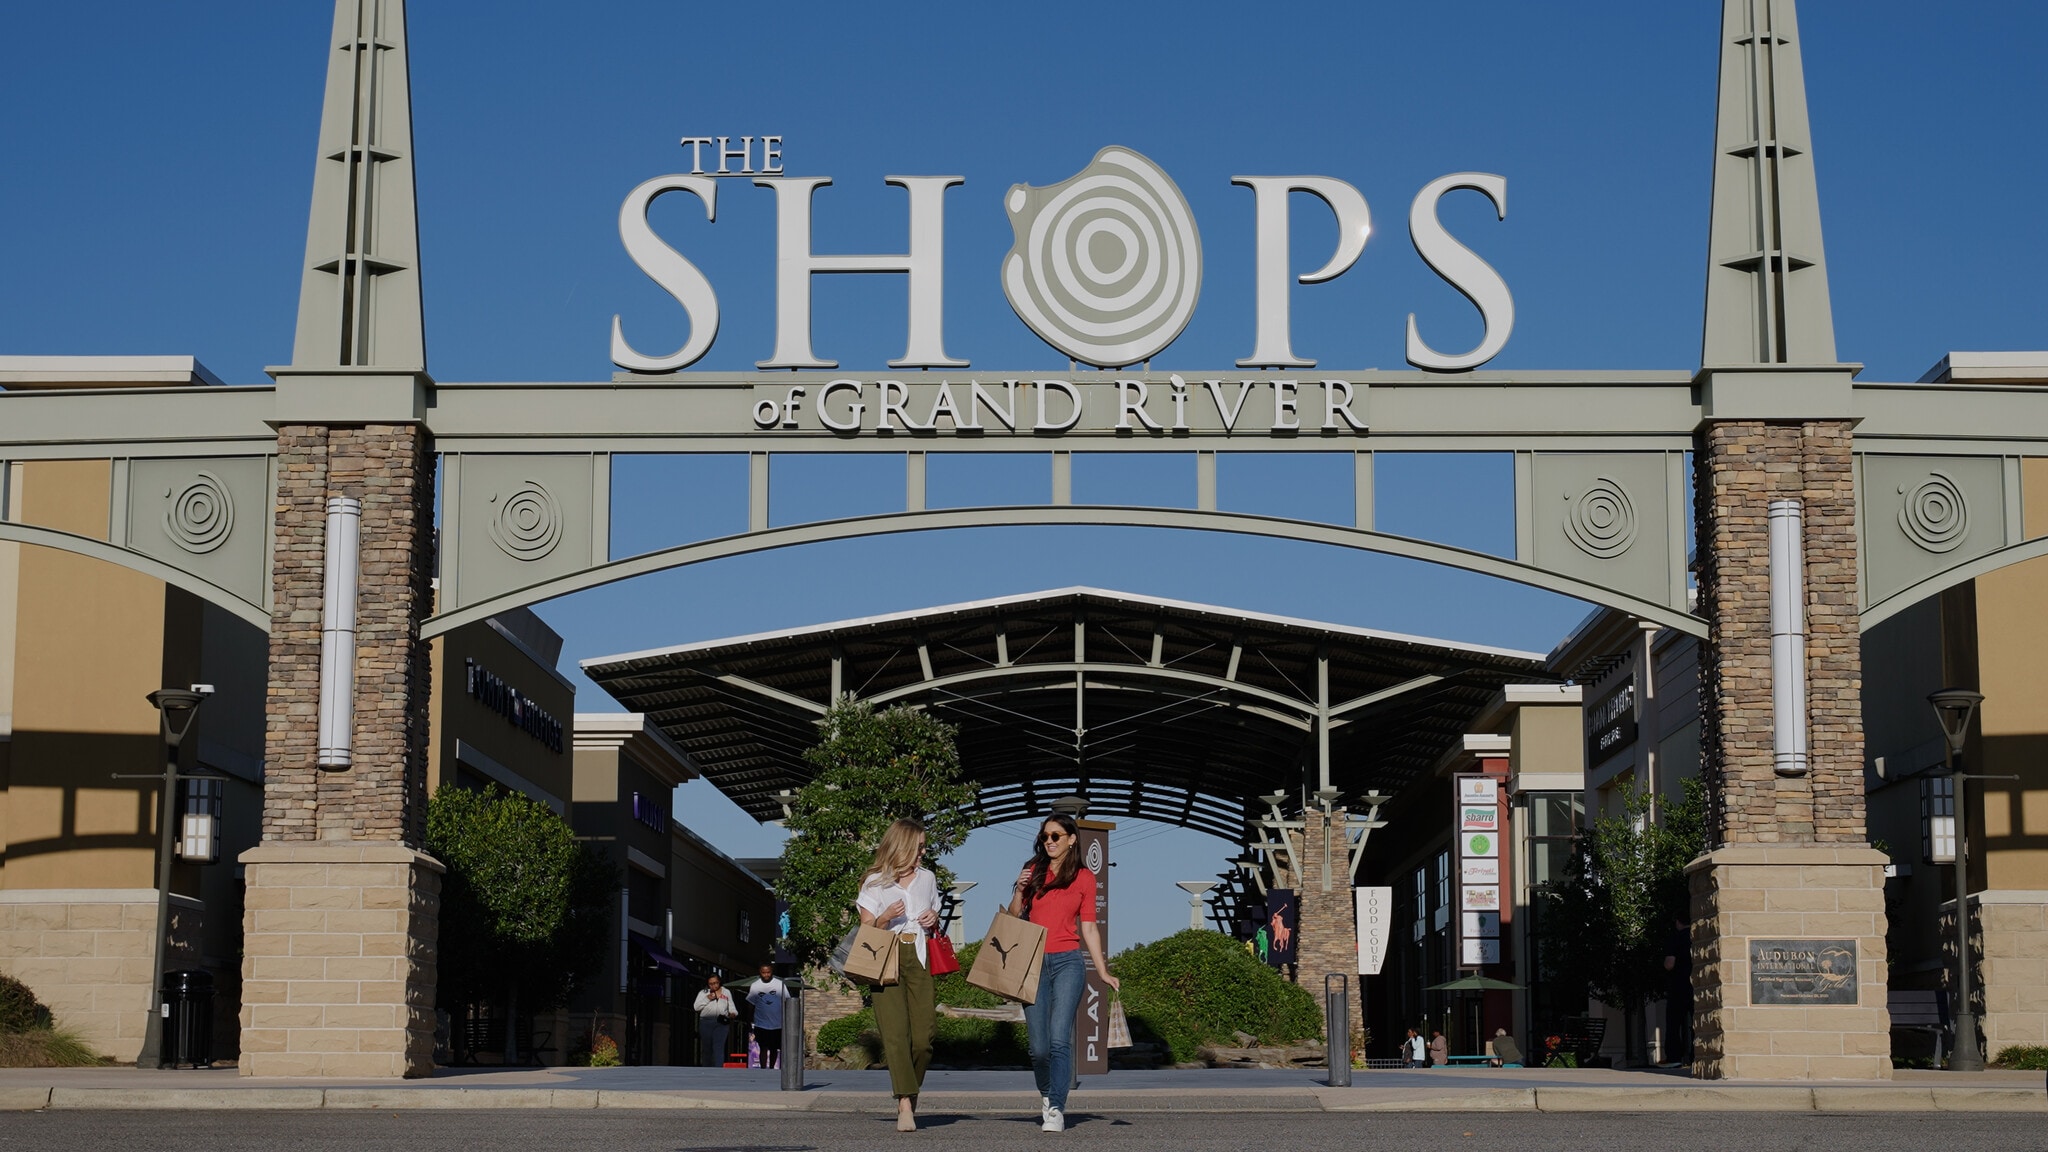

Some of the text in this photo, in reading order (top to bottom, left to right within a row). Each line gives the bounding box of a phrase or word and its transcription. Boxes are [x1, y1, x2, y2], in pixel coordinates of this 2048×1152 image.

[680, 134, 785, 175] THE
[752, 385, 805, 430] of
[815, 378, 1083, 434] GRAND
[1465, 812, 1494, 823] sbarro
[1369, 889, 1379, 972] FOOD COURT
[1757, 962, 1815, 970] INTERNATIONAL
[1758, 948, 1815, 961] AUDUBON
[1086, 983, 1099, 1062] PLAY
